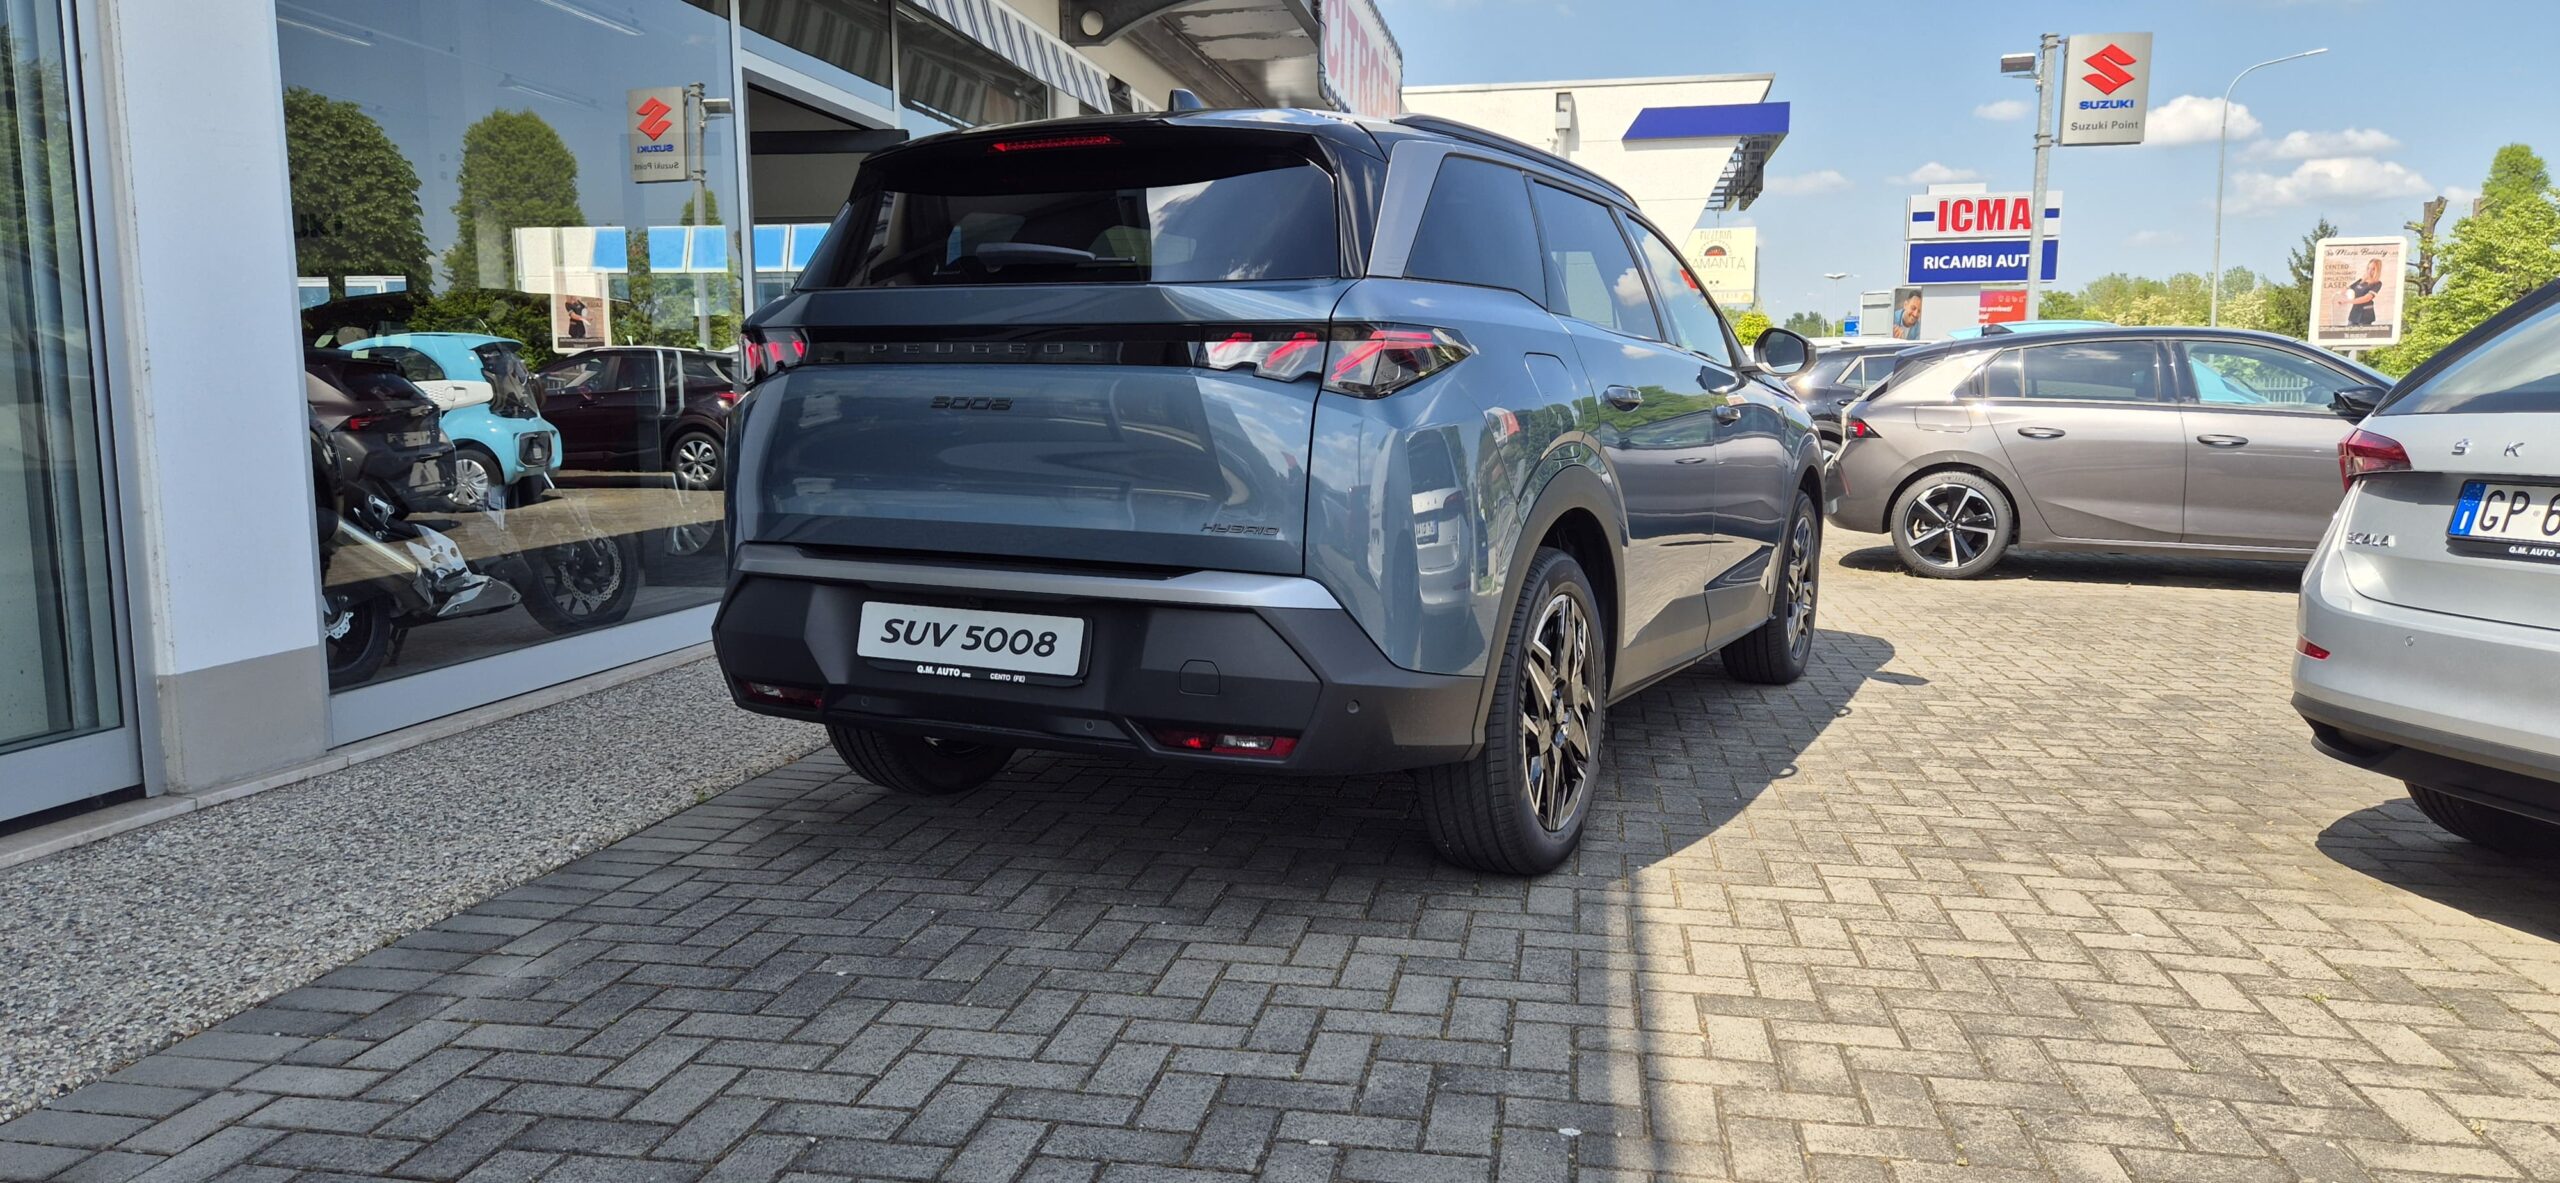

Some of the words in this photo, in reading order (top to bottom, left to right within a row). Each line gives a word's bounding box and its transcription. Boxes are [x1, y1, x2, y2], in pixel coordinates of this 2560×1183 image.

[2079, 99, 2134, 110] SUZUKI
[2070, 121, 2108, 131] Suzuki
[2111, 120, 2139, 129] Point
[1938, 197, 2032, 232] ICMA
[1687, 256, 1746, 270] AMANTA
[1923, 255, 1992, 270] RICAMBI
[1996, 254, 2030, 268] AUT
[870, 342, 1100, 354] PEUGEOT
[930, 395, 1014, 411] 5008
[1200, 523, 1280, 536] HYBRID
[2347, 532, 2395, 547] SCALA
[2529, 548, 2556, 558] AUTO
[880, 618, 959, 648] SUV
[961, 625, 1058, 658] 5008
[936, 667, 961, 678] AUTO
[990, 672, 1011, 682] CENTO
